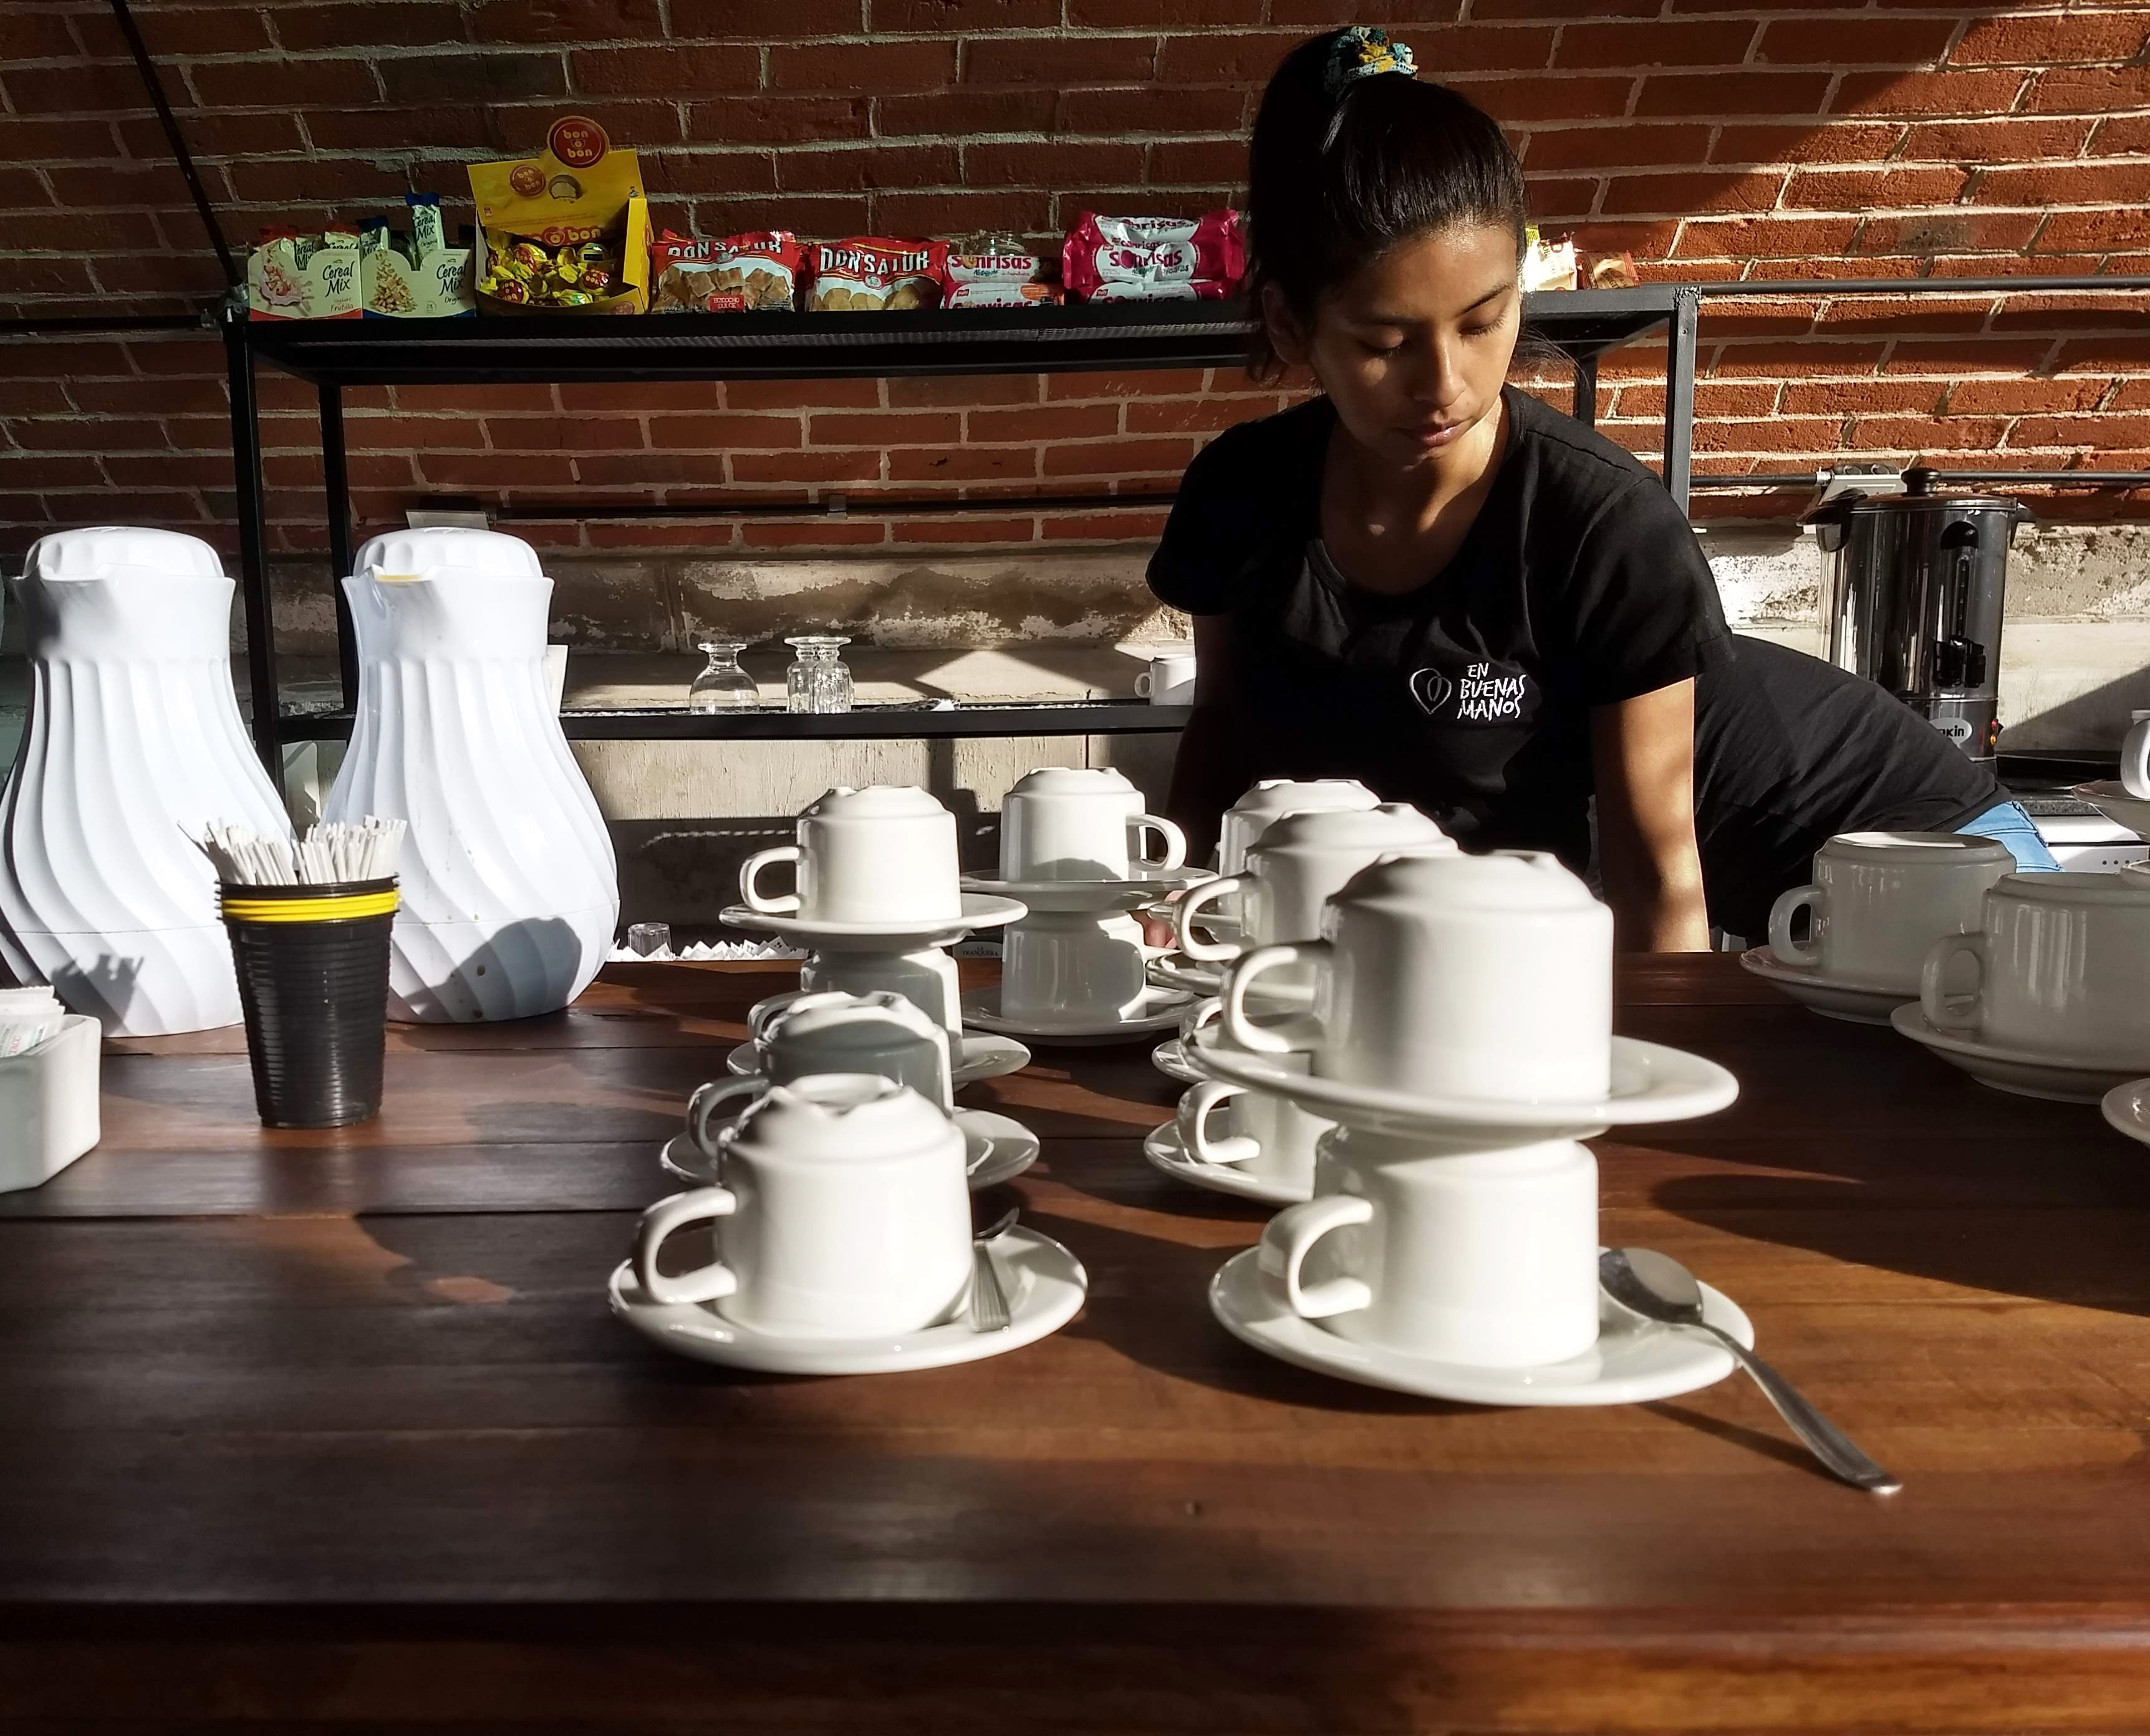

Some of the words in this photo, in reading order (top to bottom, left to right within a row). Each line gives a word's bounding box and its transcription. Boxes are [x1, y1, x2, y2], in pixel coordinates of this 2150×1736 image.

[563, 130, 589, 138] bon
[567, 148, 593, 158] bon
[517, 169, 534, 178] bon
[524, 180, 541, 189] bon
[417, 225, 435, 240] Mix
[567, 228, 601, 241] bon
[322, 261, 355, 280] Cereal
[437, 259, 468, 280] Cereal
[325, 278, 350, 297] Mix
[439, 278, 463, 296] Mix
[1467, 662, 1489, 679] EN
[1460, 673, 1526, 700] BUENAS
[1457, 695, 1522, 721] MANOS
